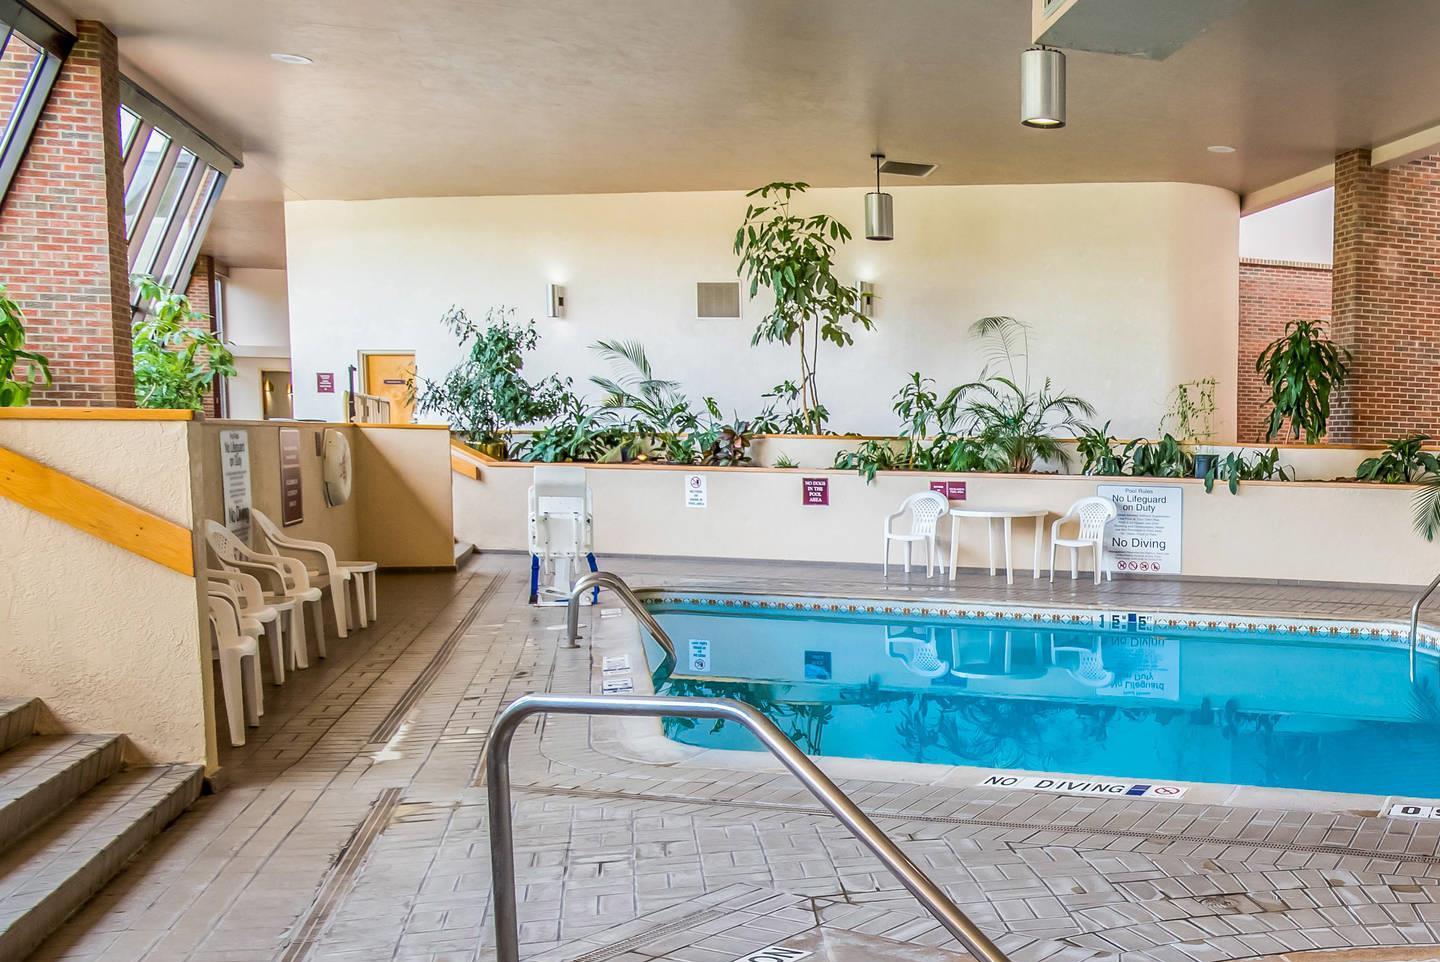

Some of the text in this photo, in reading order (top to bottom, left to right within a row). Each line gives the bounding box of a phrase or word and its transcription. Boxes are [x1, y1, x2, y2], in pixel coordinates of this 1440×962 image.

[1112, 494, 1166, 504] No Lifeguard
[1136, 504, 1156, 512] Duty
[1112, 538, 1166, 551] No Diving
[984, 776, 1126, 793] NO DIVING
